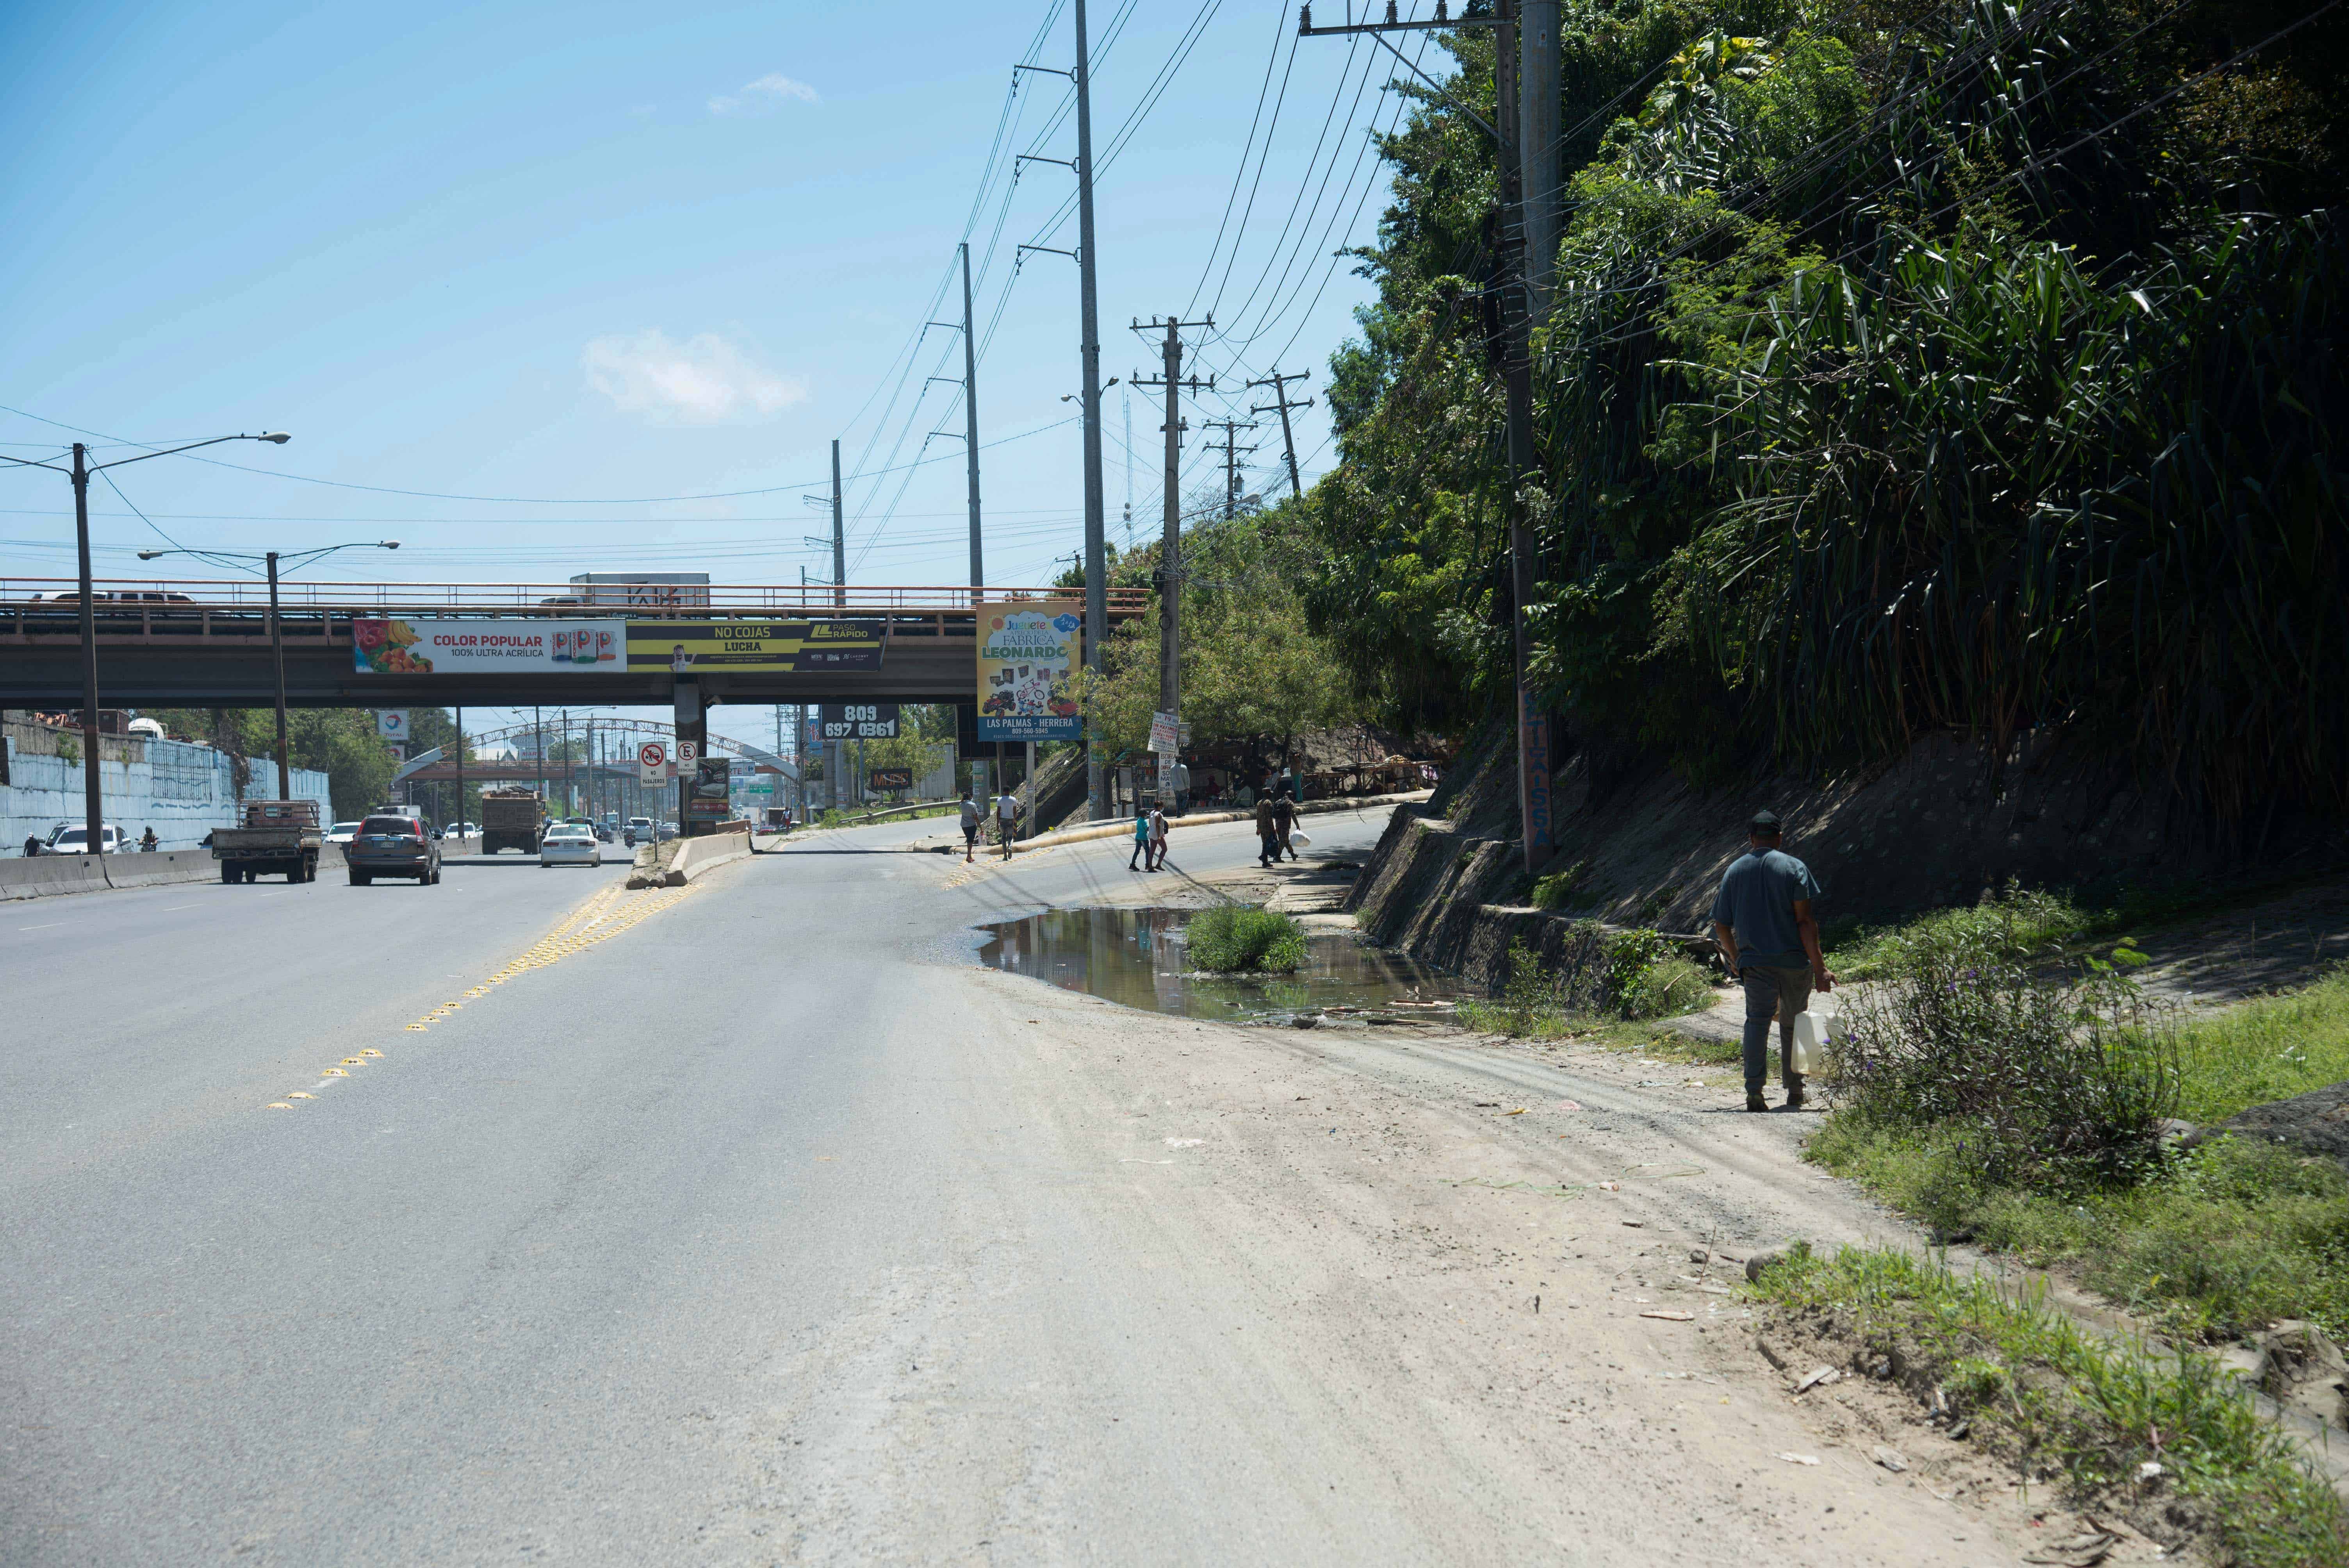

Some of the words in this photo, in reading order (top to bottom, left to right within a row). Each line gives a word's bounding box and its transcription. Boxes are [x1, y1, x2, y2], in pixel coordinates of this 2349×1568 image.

[1007, 620, 1051, 630] Juguetes
[715, 627, 733, 638] NO
[735, 627, 770, 638] COJAS
[434, 635, 478, 646] COLOR
[481, 636, 543, 647] POPULAR
[725, 642, 762, 651] LUCHA
[476, 649, 503, 657] ULTRA
[506, 647, 544, 657] ACRÍLICA
[982, 647, 1069, 658] LEONARDO
[845, 706, 877, 721] 809
[825, 723, 852, 736] 697
[859, 719, 895, 736] 0361
[987, 719, 1000, 727] LAS
[1003, 719, 1032, 727] PALMAS
[1039, 718, 1073, 727] HERRERA
